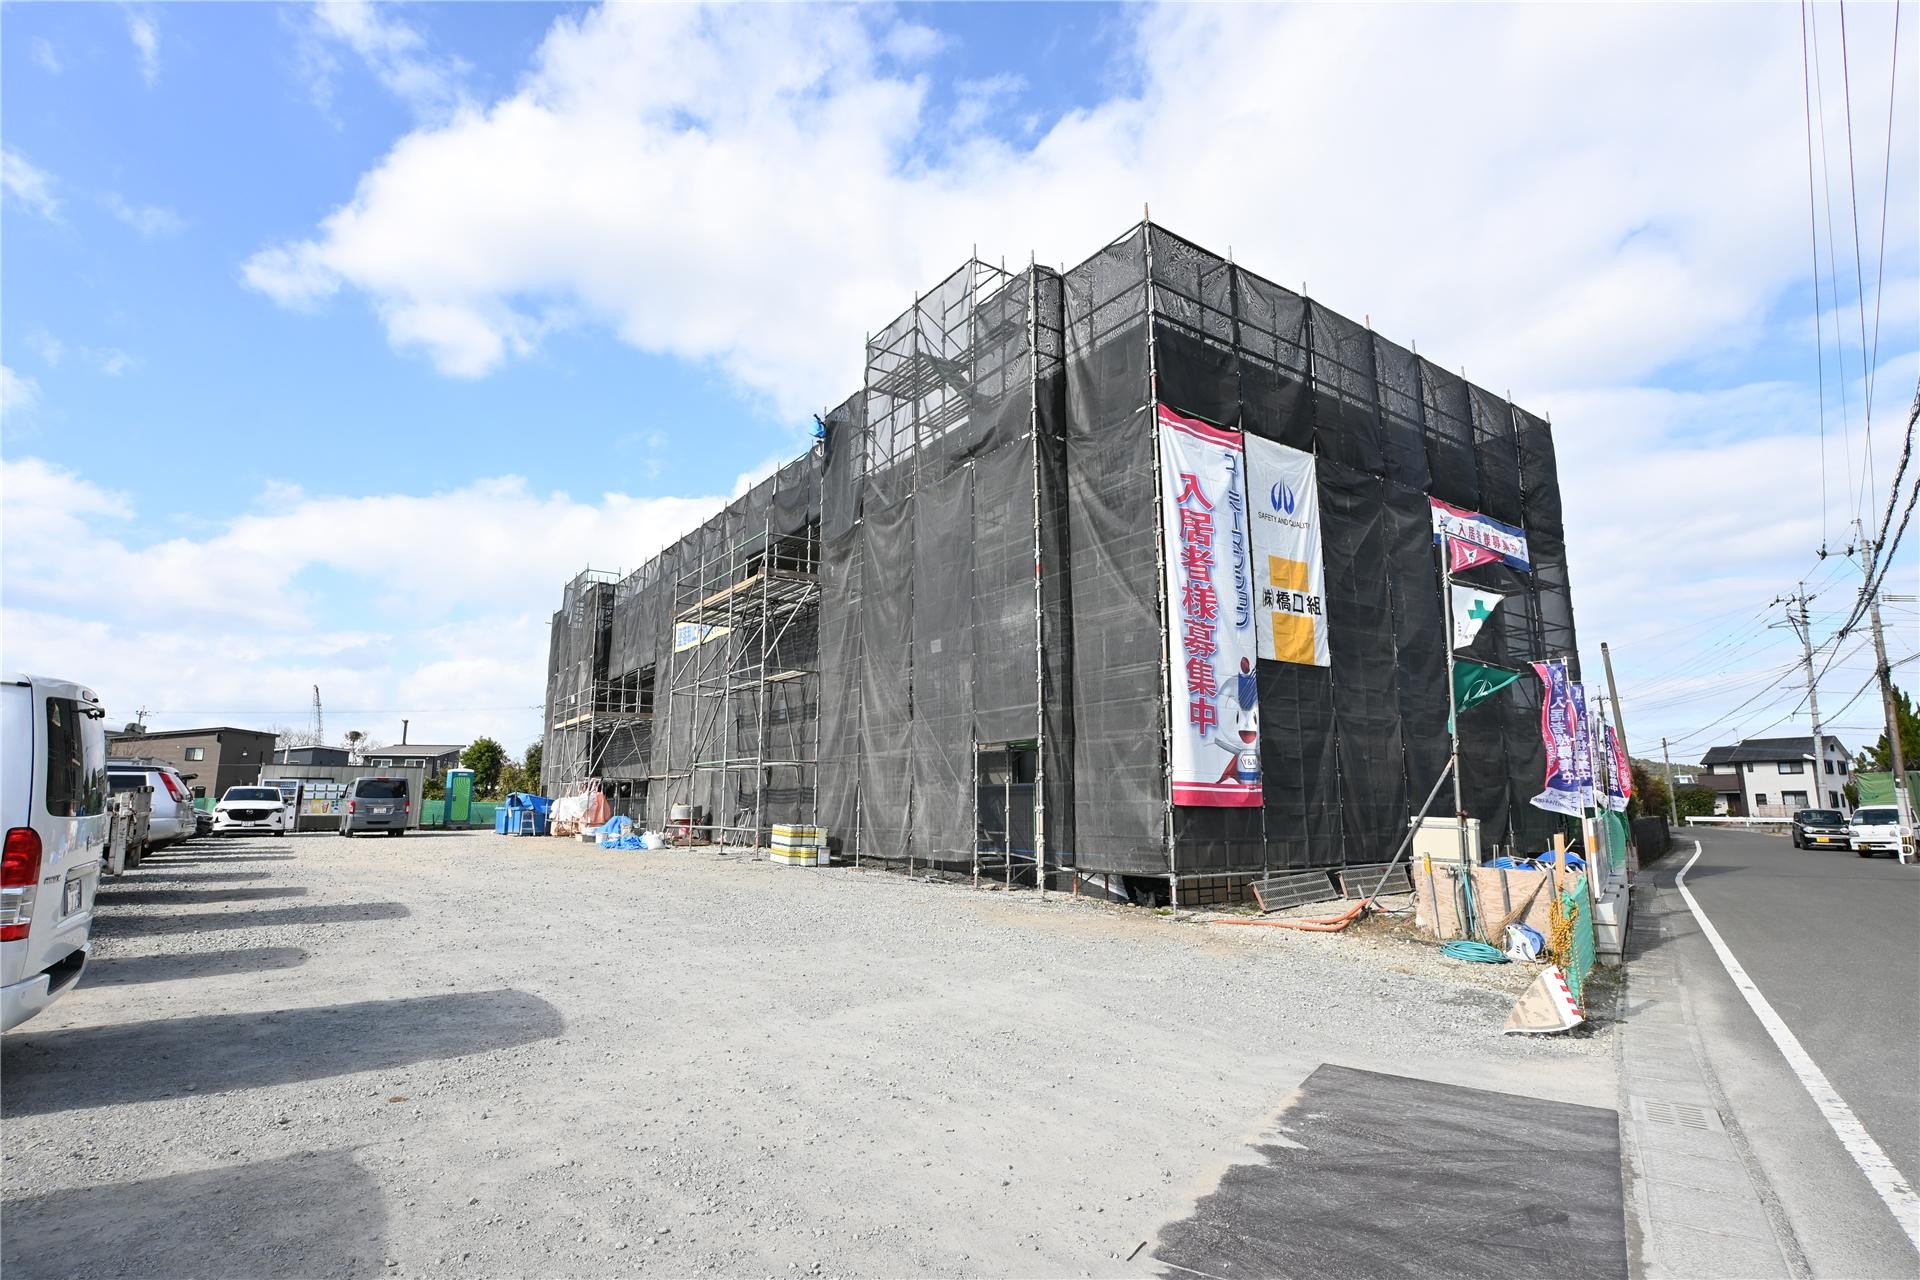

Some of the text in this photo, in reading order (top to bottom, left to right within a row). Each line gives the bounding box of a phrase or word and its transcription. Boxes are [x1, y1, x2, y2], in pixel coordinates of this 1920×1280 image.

[1176, 473, 1218, 735] 入居者様募集中
[1224, 453, 1249, 627] ユミーマンション
[1257, 511, 1277, 523] SAFETY
[1277, 517, 1289, 526] AND
